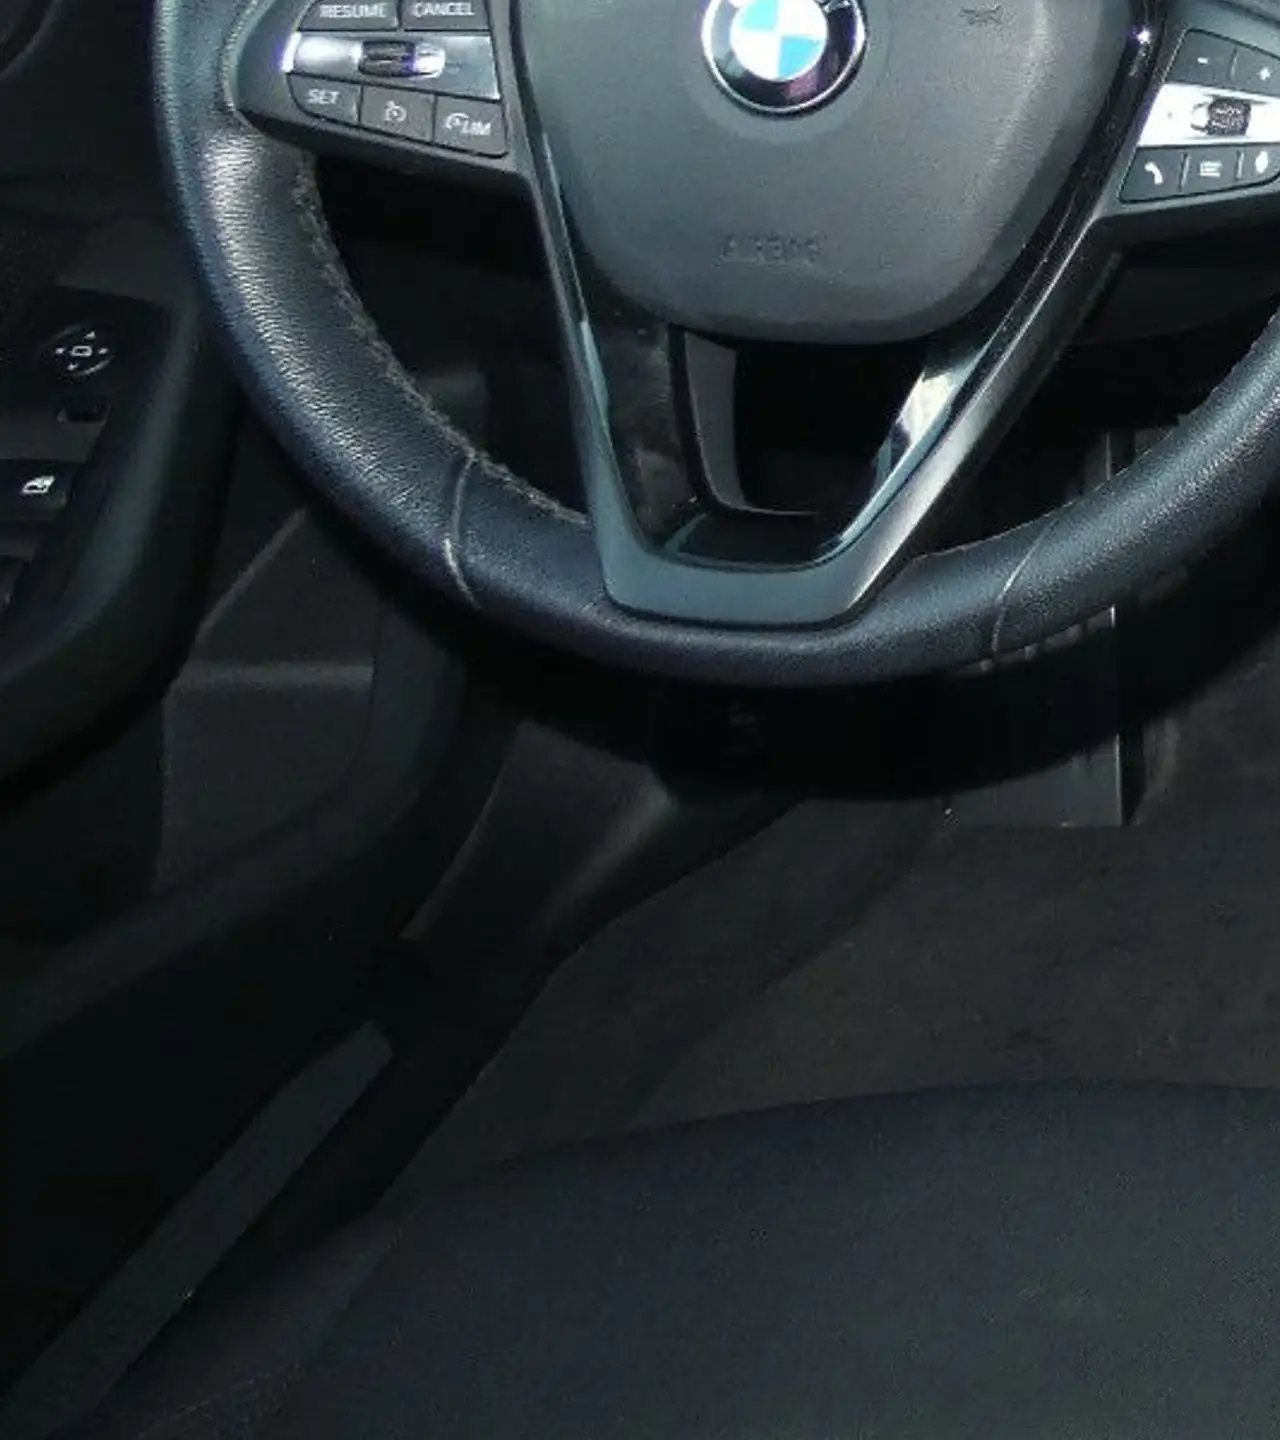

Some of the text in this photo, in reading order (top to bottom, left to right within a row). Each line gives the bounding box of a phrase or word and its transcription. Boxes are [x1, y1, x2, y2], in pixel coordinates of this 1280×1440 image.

[319, 2, 388, 19] RESUME
[412, 1, 476, 17] CANCEL
[308, 88, 341, 106] SET
[461, 119, 492, 136] LIM
